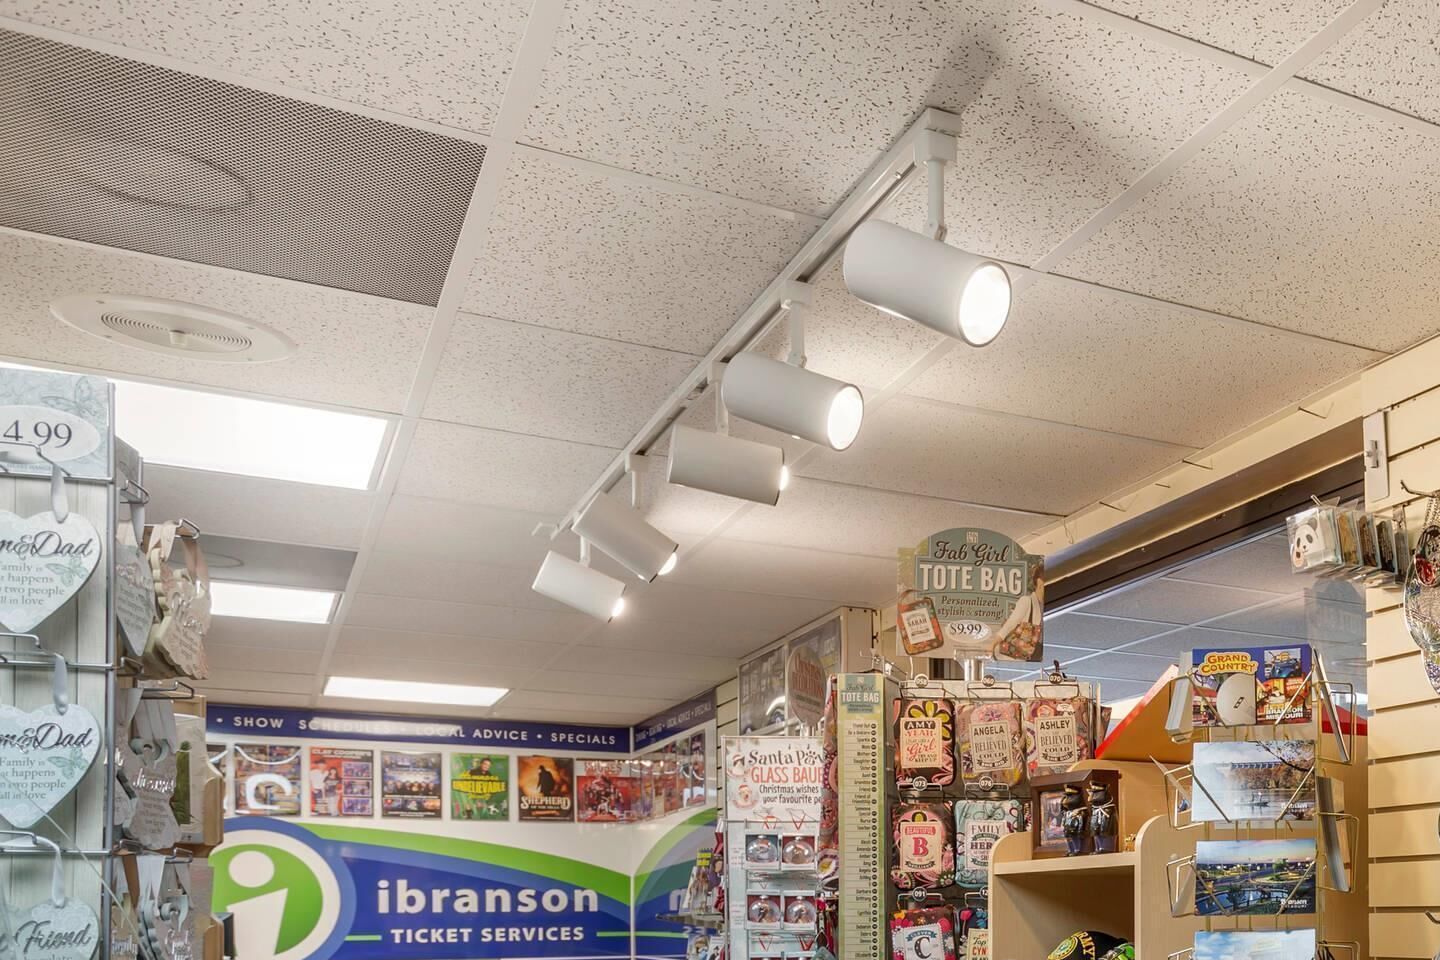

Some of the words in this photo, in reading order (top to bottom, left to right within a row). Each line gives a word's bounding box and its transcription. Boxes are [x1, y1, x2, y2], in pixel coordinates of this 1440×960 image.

[934, 540, 968, 561] Fab
[971, 543, 1010, 567] Girl
[919, 563, 973, 591] TOTE
[980, 565, 1023, 596] BAG
[937, 604, 967, 618] stylish
[1207, 653, 1250, 664] GRAND
[1200, 662, 1256, 674] COUNTRY
[842, 692, 861, 702] TOTE
[863, 692, 880, 703] BAG
[233, 715, 284, 729] SHOW
[472, 728, 528, 741] ADVICE
[551, 732, 617, 745] SPECIALS
[907, 720, 934, 730] AMY
[973, 725, 1005, 737] ANGELA
[1039, 719, 1071, 730] ASHLEY
[974, 740, 1007, 752] BELIEVED
[1040, 735, 1073, 747] BELIEVED
[748, 749, 794, 766] Santa
[12, 767, 56, 782] happens
[751, 766, 789, 784] GLASS
[30, 779, 67, 794] people
[759, 784, 795, 795] Christmas
[796, 785, 819, 794] wishes
[520, 796, 572, 811] SHEPHERD
[778, 793, 812, 805] favourite
[912, 837, 929, 857] B
[377, 878, 599, 914] ibranson
[914, 890, 926, 898] 091
[16, 919, 92, 954] Friend
[391, 928, 473, 944] TICKET
[480, 926, 585, 943] SERVICES
[913, 936, 931, 959] C
